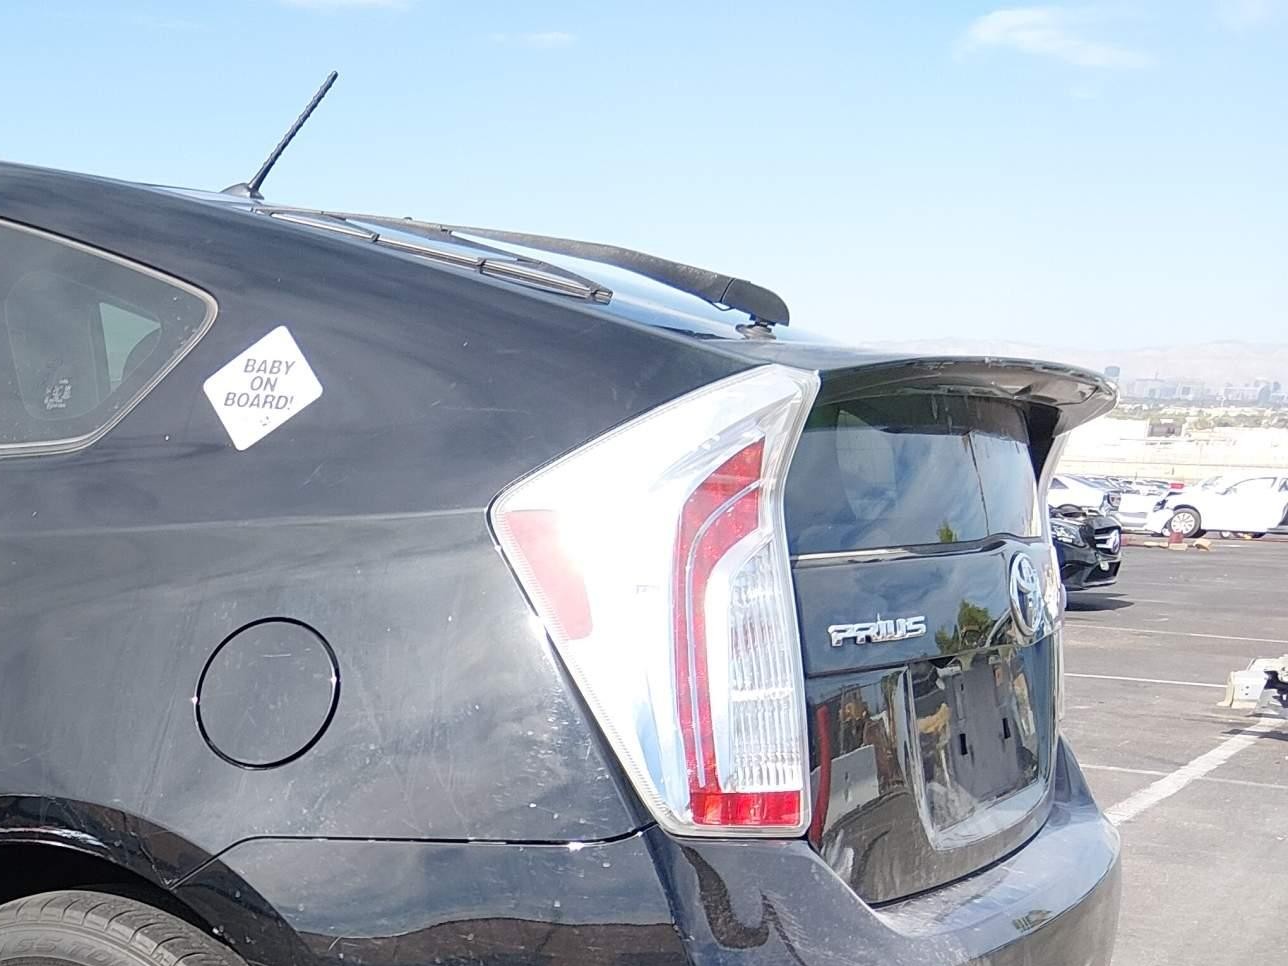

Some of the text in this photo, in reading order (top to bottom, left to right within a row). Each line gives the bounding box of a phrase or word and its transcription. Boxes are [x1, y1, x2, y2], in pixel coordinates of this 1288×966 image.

[243, 358, 296, 375] BABY
[250, 376, 278, 392] ON
[223, 392, 294, 411] BOARD!
[827, 615, 927, 647] PRIUS
